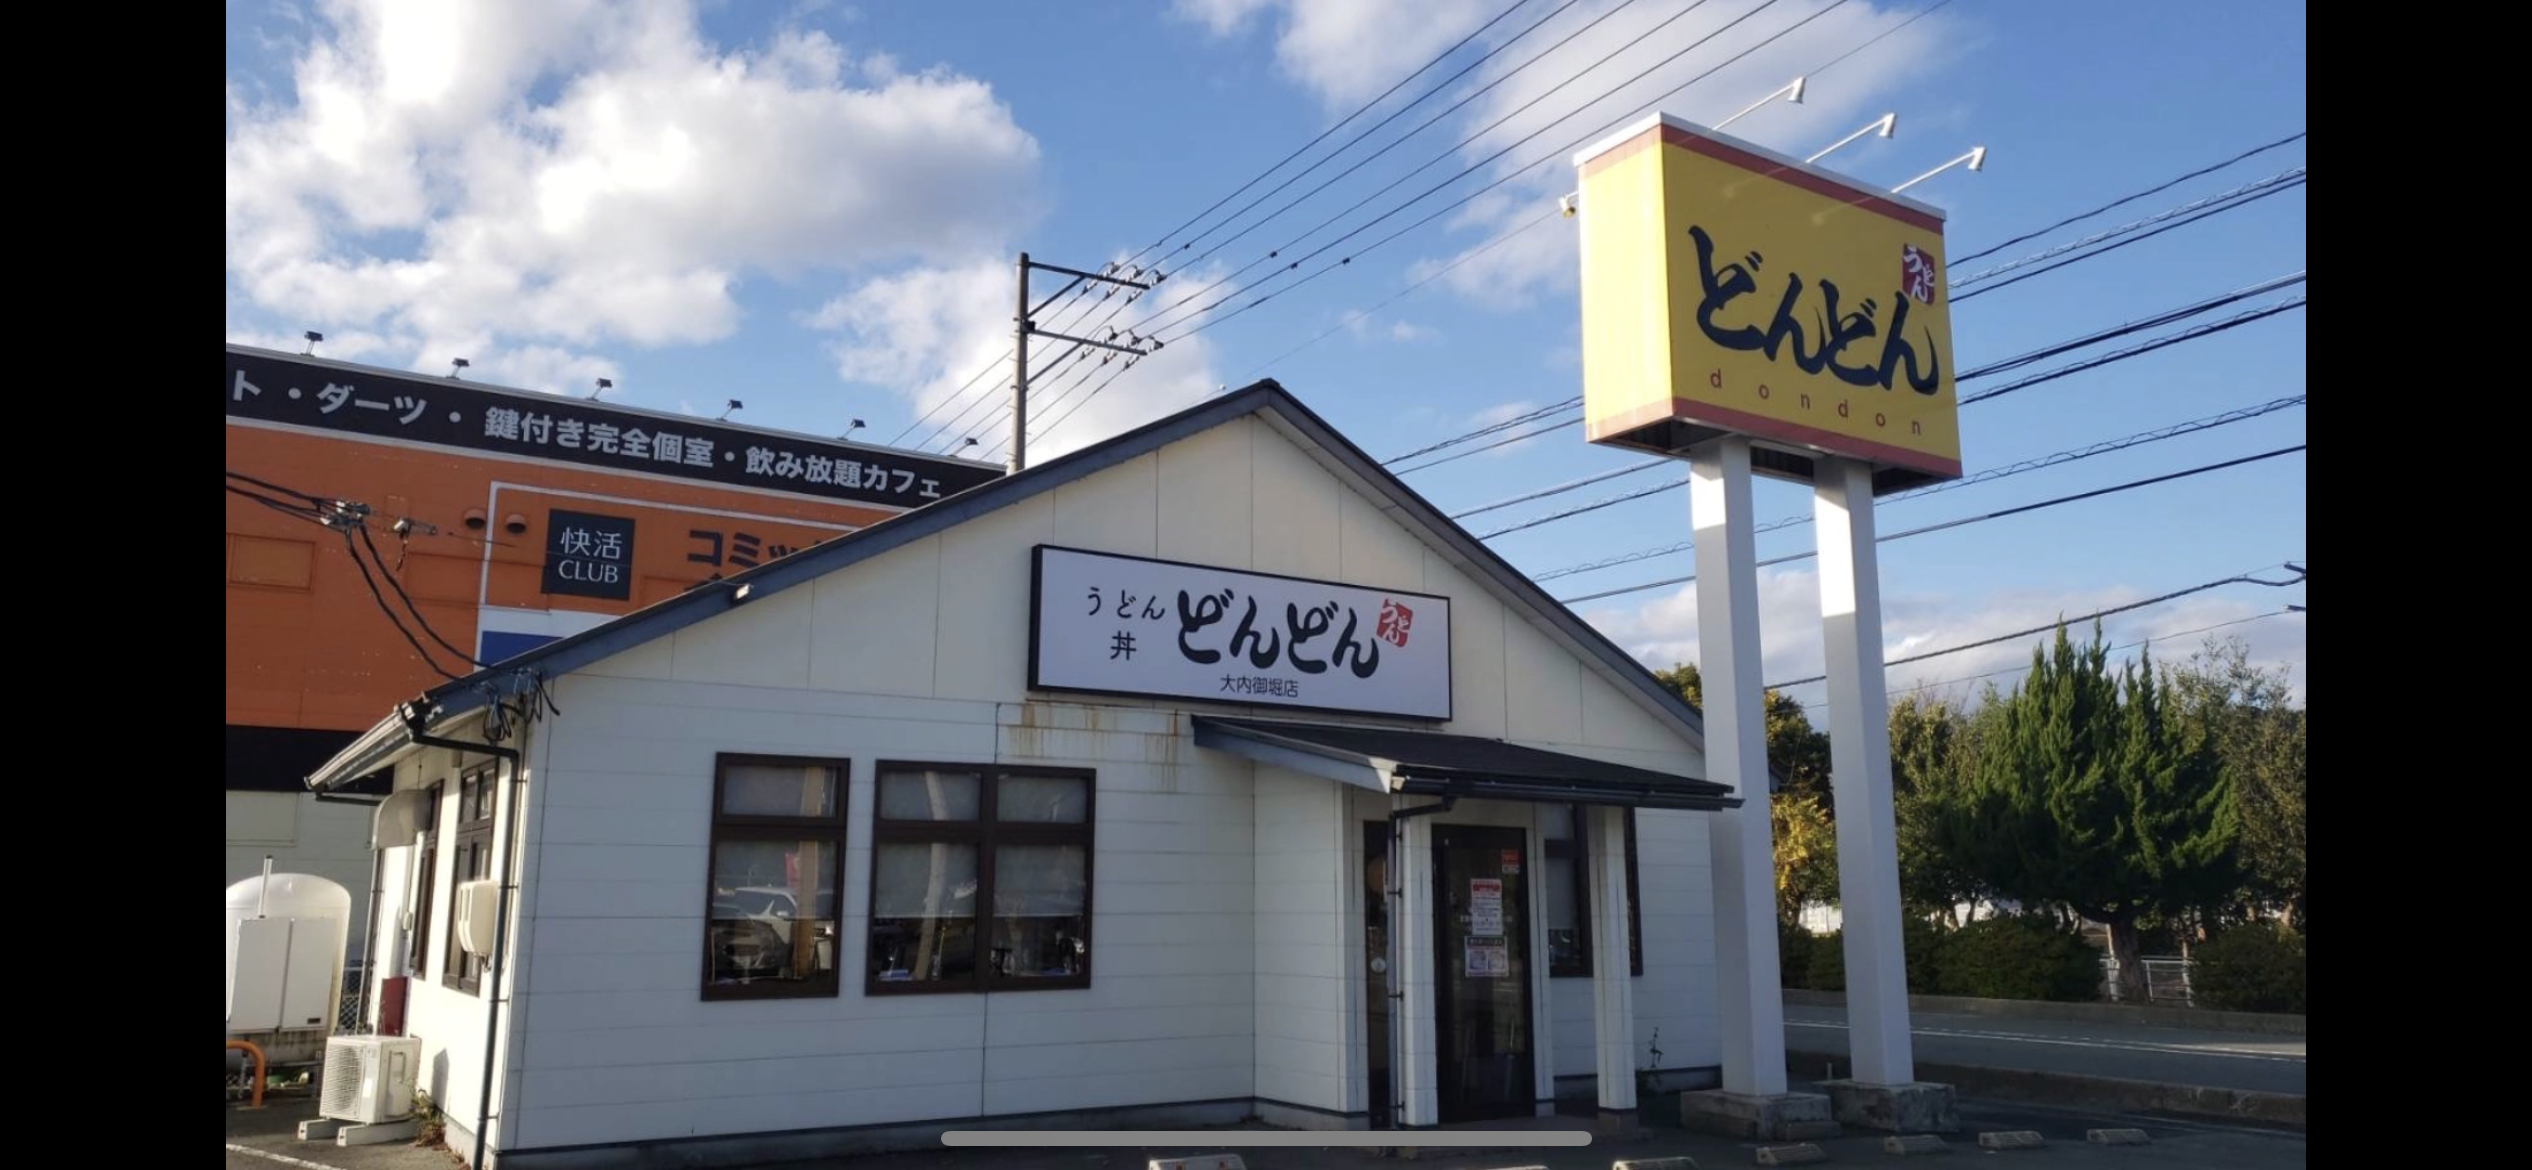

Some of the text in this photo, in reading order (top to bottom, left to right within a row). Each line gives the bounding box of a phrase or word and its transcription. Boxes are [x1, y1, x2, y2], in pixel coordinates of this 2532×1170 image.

[1688, 226, 1939, 395] どんどん
[560, 526, 622, 560] 快活
[558, 559, 619, 584] CLUB
[1087, 588, 1165, 620] うどん
[1110, 630, 1137, 661] 丼
[1178, 589, 1379, 678] どんどん
[1220, 673, 1299, 698] 大内御堀店
